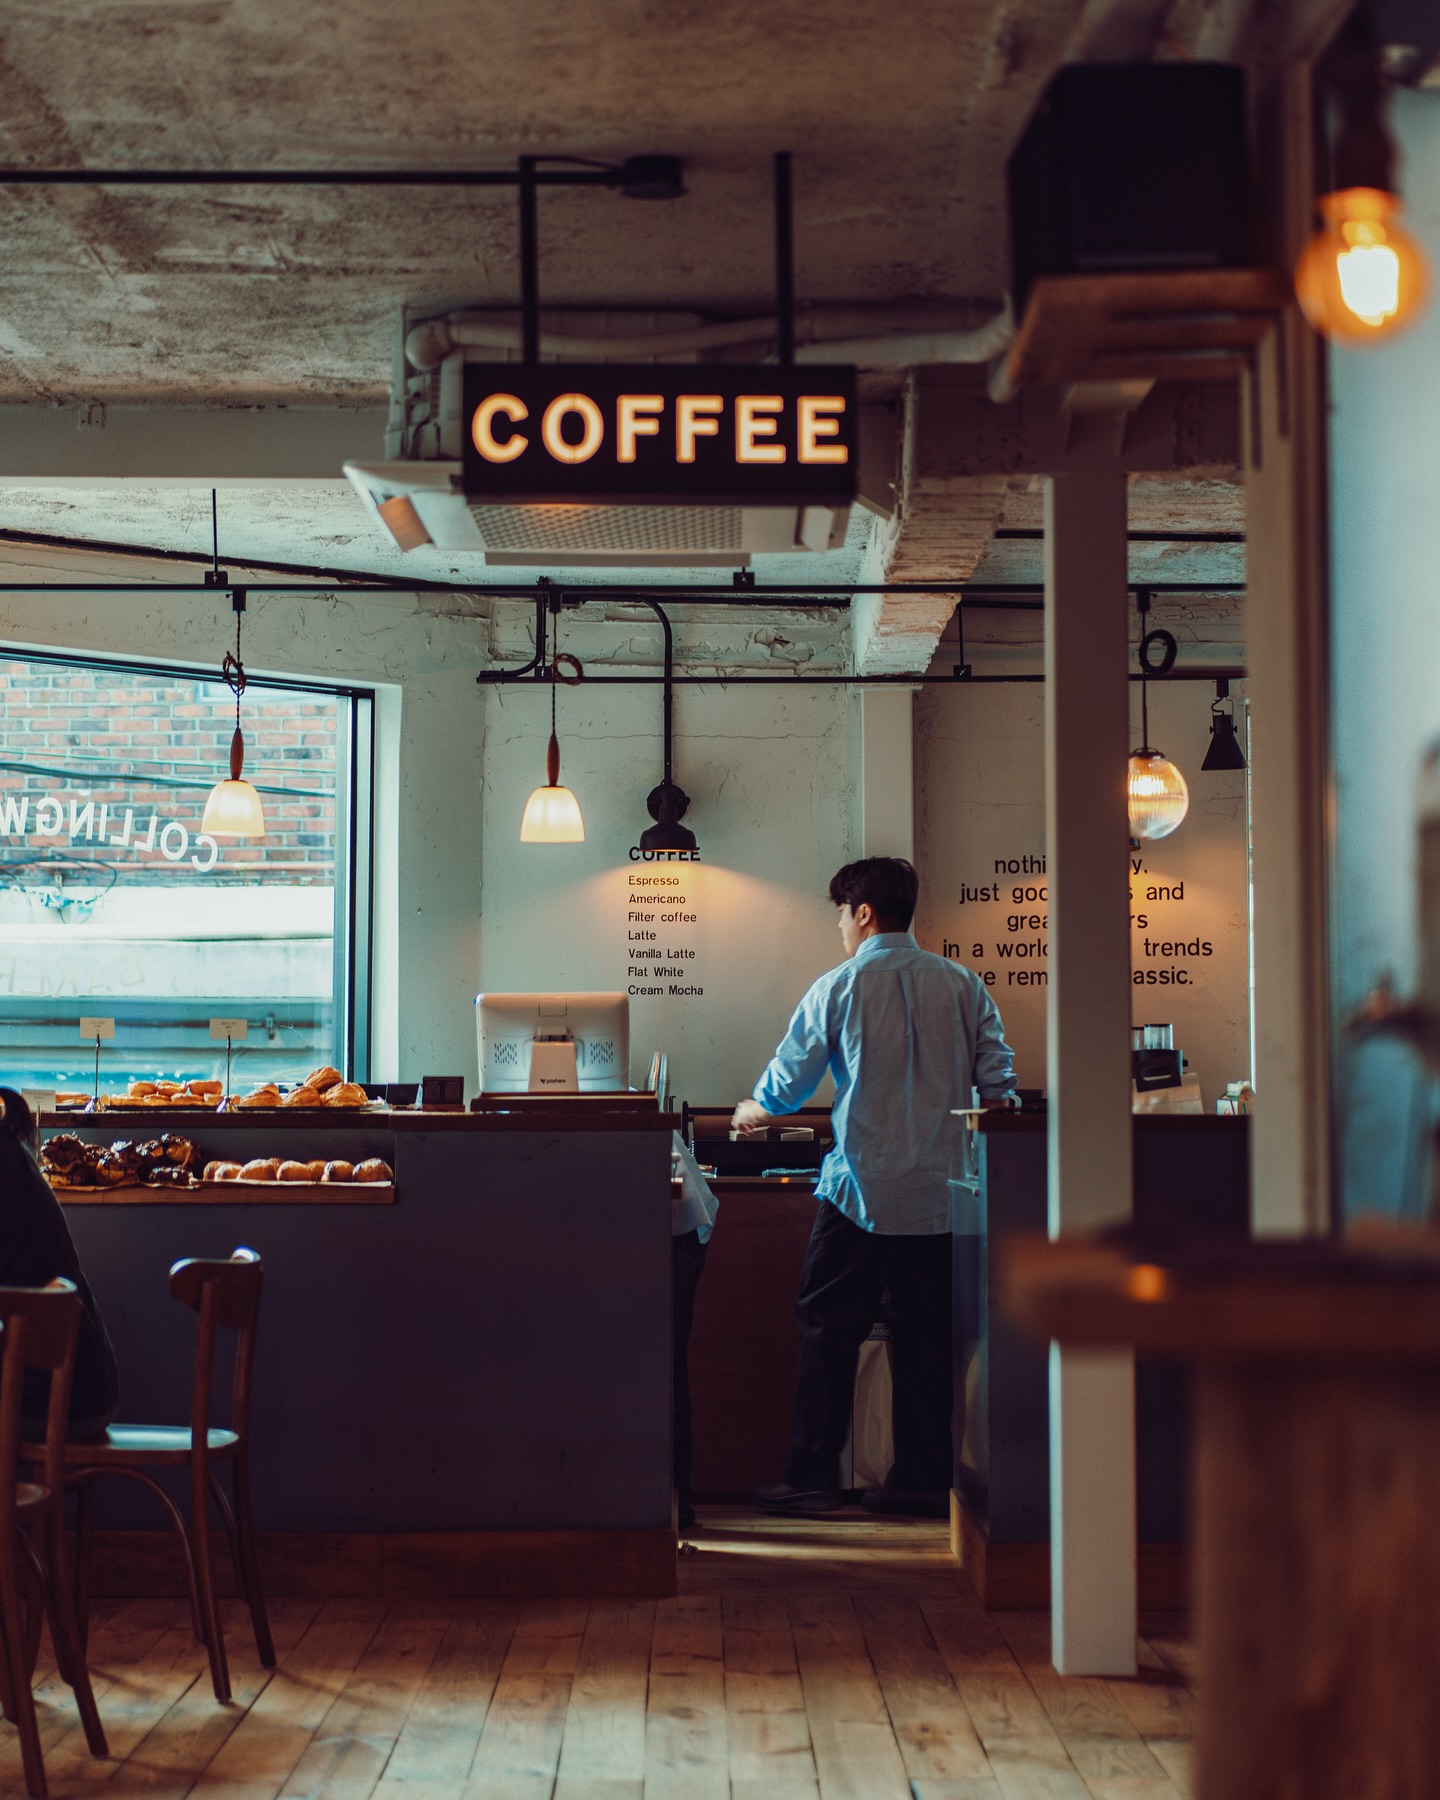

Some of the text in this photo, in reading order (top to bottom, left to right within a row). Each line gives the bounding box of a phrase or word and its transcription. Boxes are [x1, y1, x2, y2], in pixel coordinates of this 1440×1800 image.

[471, 392, 849, 464] COFFEE
[629, 846, 701, 861] COFFEE
[628, 875, 680, 887] Espresso
[628, 893, 686, 904] Americano
[959, 883, 1000, 904] just
[1146, 882, 1184, 900] and
[628, 911, 697, 922] Filter coffee
[628, 930, 657, 941] Latte
[628, 948, 696, 959] Vanilla Latte
[943, 939, 960, 958] in
[972, 943, 984, 958] a
[1144, 937, 1213, 957] trends
[628, 966, 684, 977] Flat White
[628, 984, 704, 996] Cream Mocha
